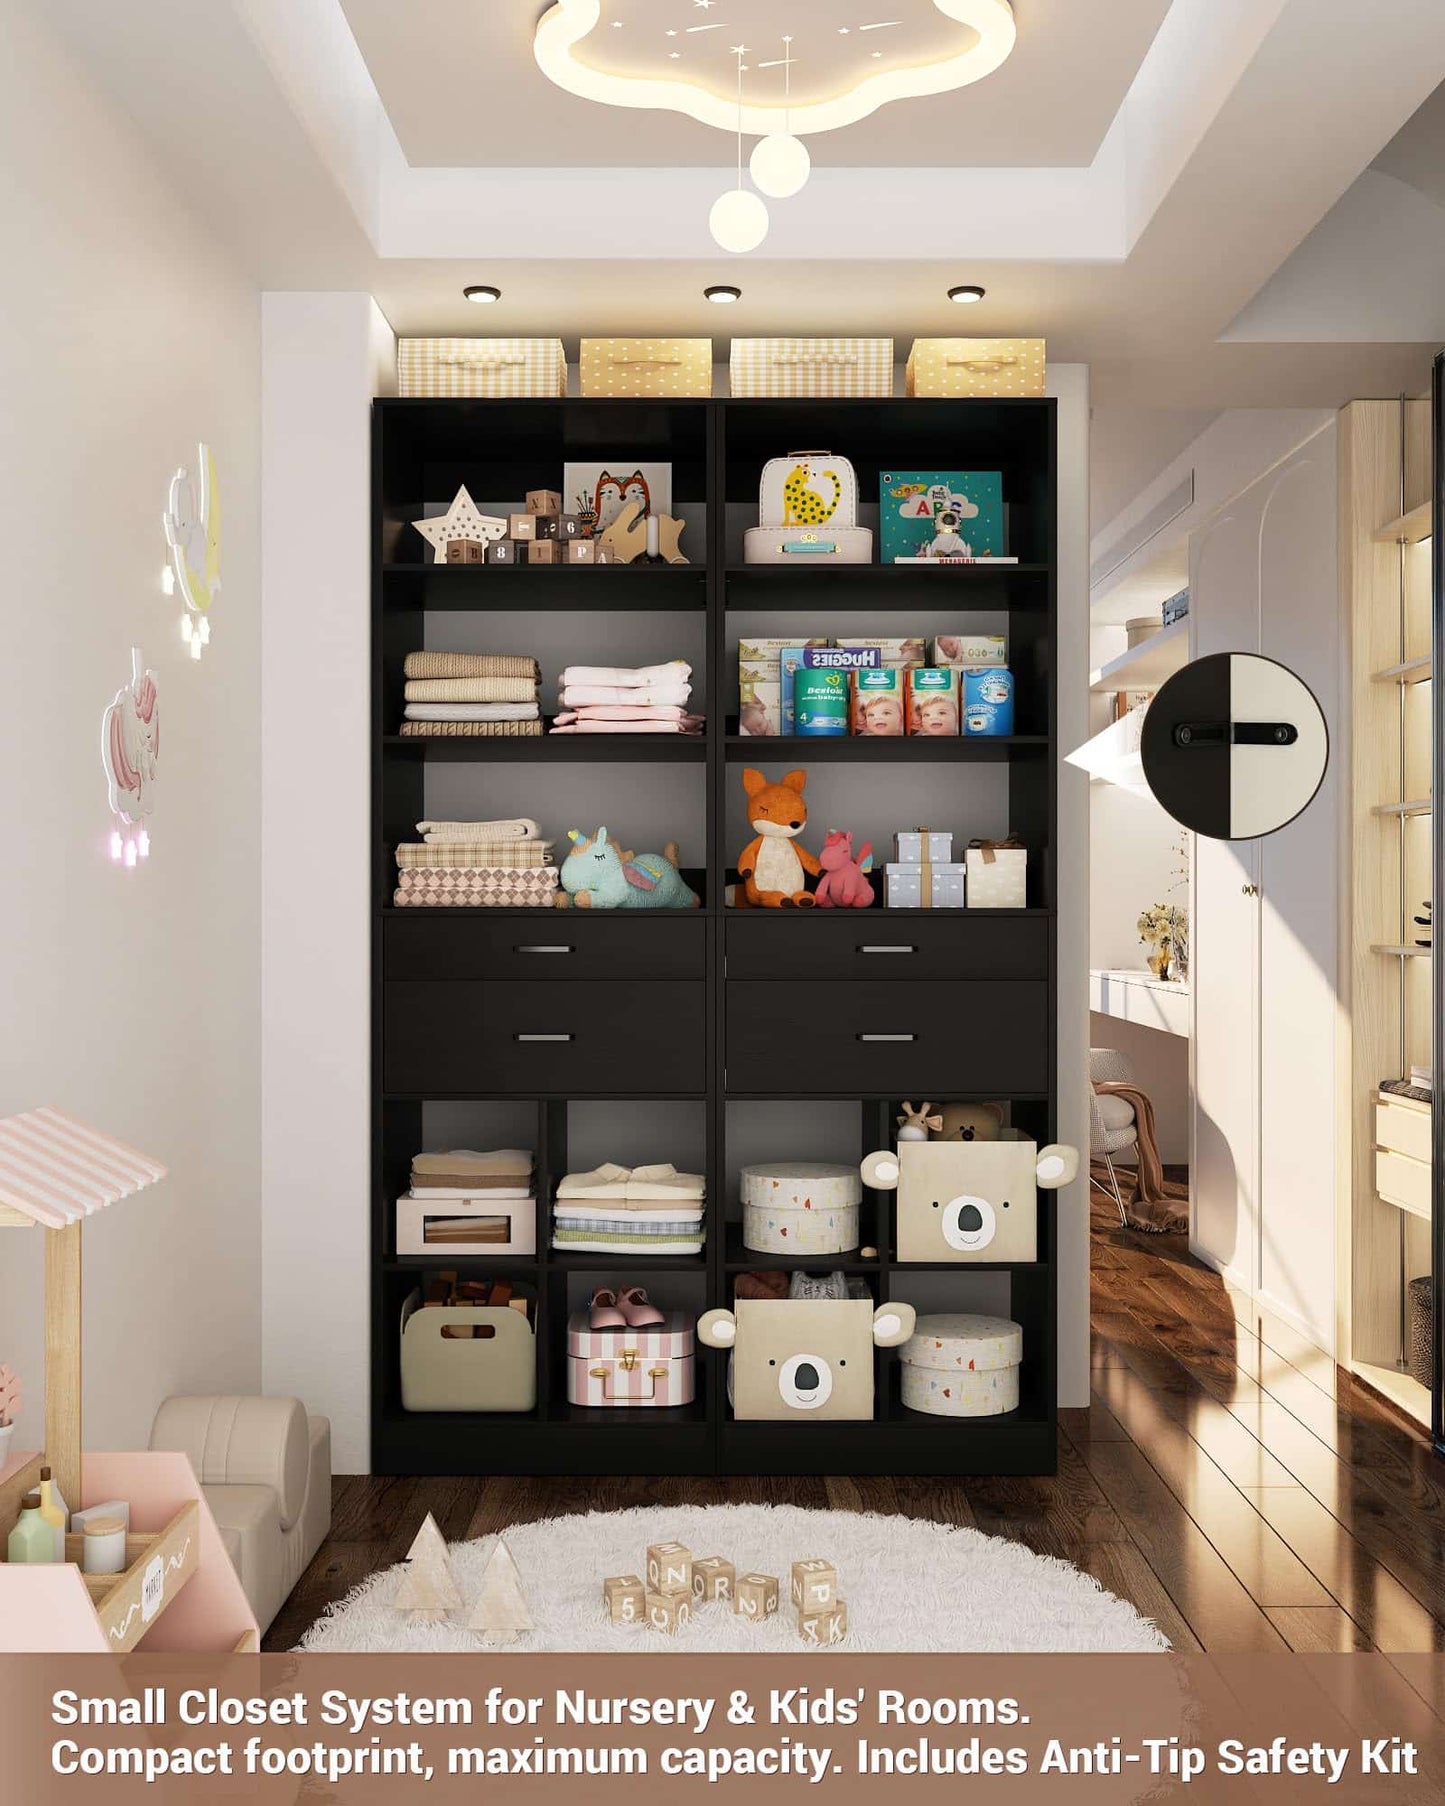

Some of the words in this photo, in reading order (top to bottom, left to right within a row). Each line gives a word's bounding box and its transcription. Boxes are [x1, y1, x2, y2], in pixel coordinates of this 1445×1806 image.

[566, 521, 575, 534] 6
[496, 546, 506, 559] 8
[577, 546, 587, 558] P
[598, 552, 607, 563] A
[800, 712, 807, 721] 4
[667, 1564, 686, 1585] N
[715, 1577, 732, 1601] R
[811, 1584, 830, 1603] P
[622, 1597, 635, 1620] 5
[829, 1614, 845, 1642] K
